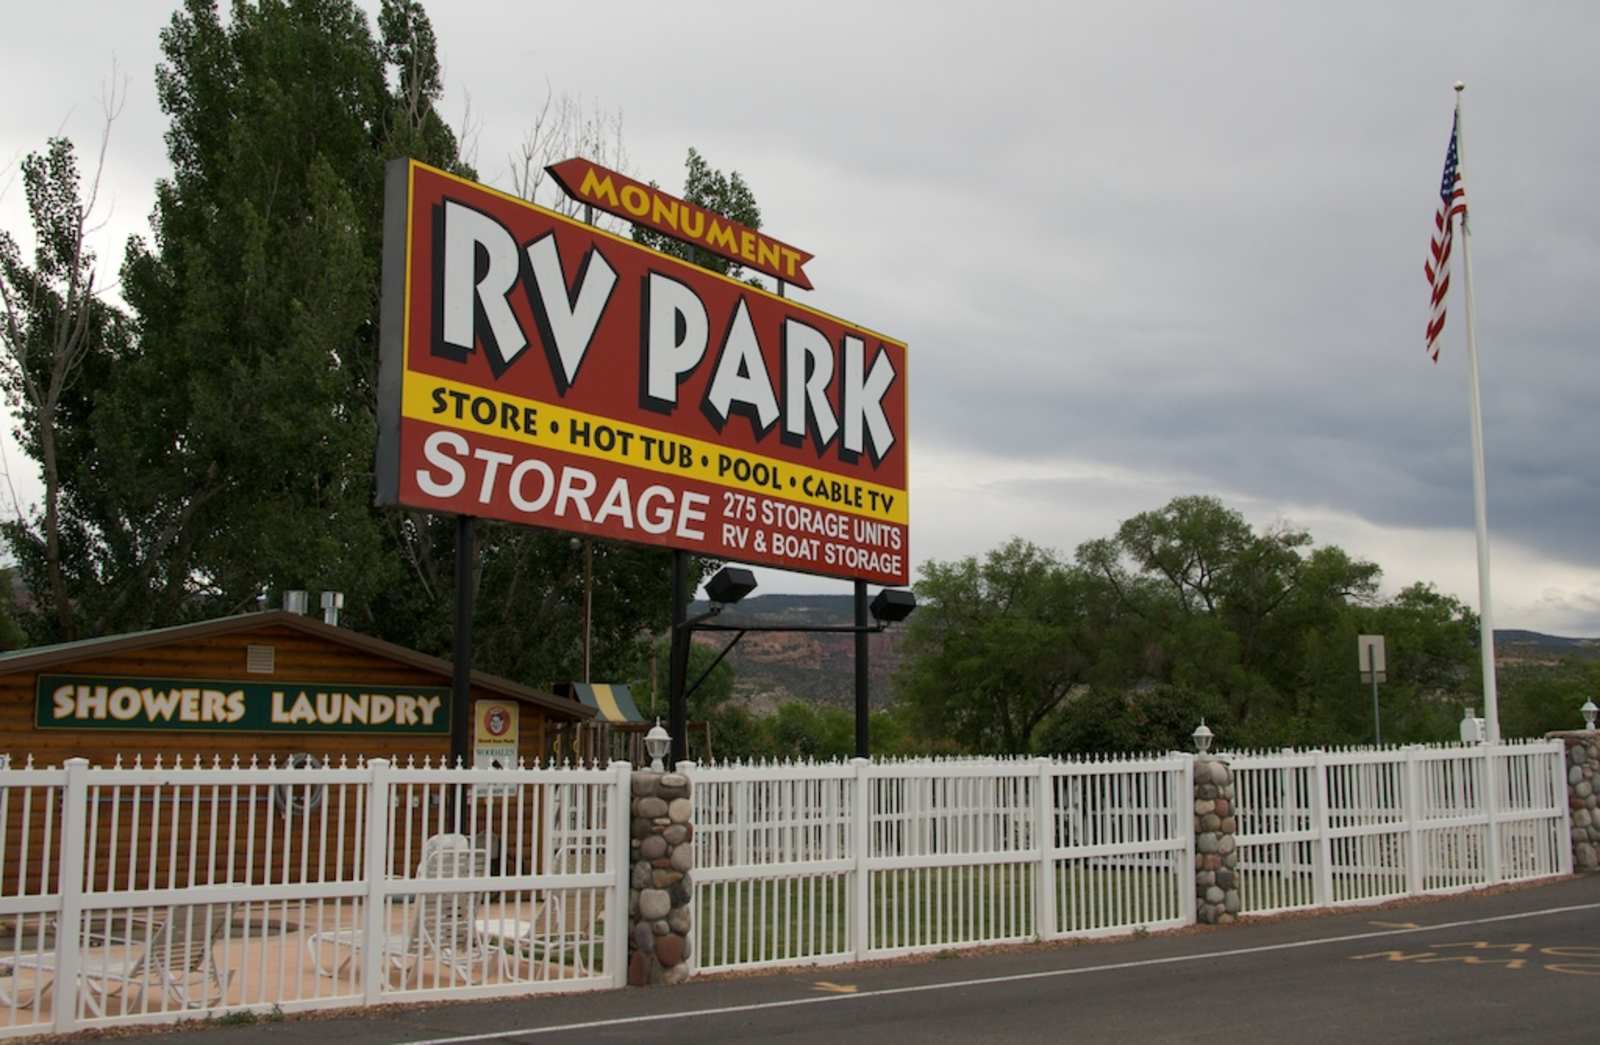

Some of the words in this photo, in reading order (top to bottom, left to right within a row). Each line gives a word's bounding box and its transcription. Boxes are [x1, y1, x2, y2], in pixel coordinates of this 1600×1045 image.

[579, 167, 801, 277] MONUMENT
[439, 199, 619, 392] RV
[645, 271, 897, 466] PARK
[415, 430, 710, 541] STORAGE
[431, 387, 538, 436] STORE
[569, 418, 634, 456] HOT
[640, 434, 694, 468] TUB
[718, 453, 782, 490] POOL
[802, 475, 863, 508] CABLE
[868, 490, 895, 513] TV
[722, 523, 749, 549] RV
[753, 530, 767, 553] &
[772, 533, 821, 561] BOAT
[824, 542, 902, 576] STORAGE
[723, 491, 757, 522] 275
[761, 499, 849, 541] STORAGE
[853, 518, 902, 550] UNITS
[52, 685, 246, 724] SHOWERS
[271, 690, 442, 726] LAUNDRY
